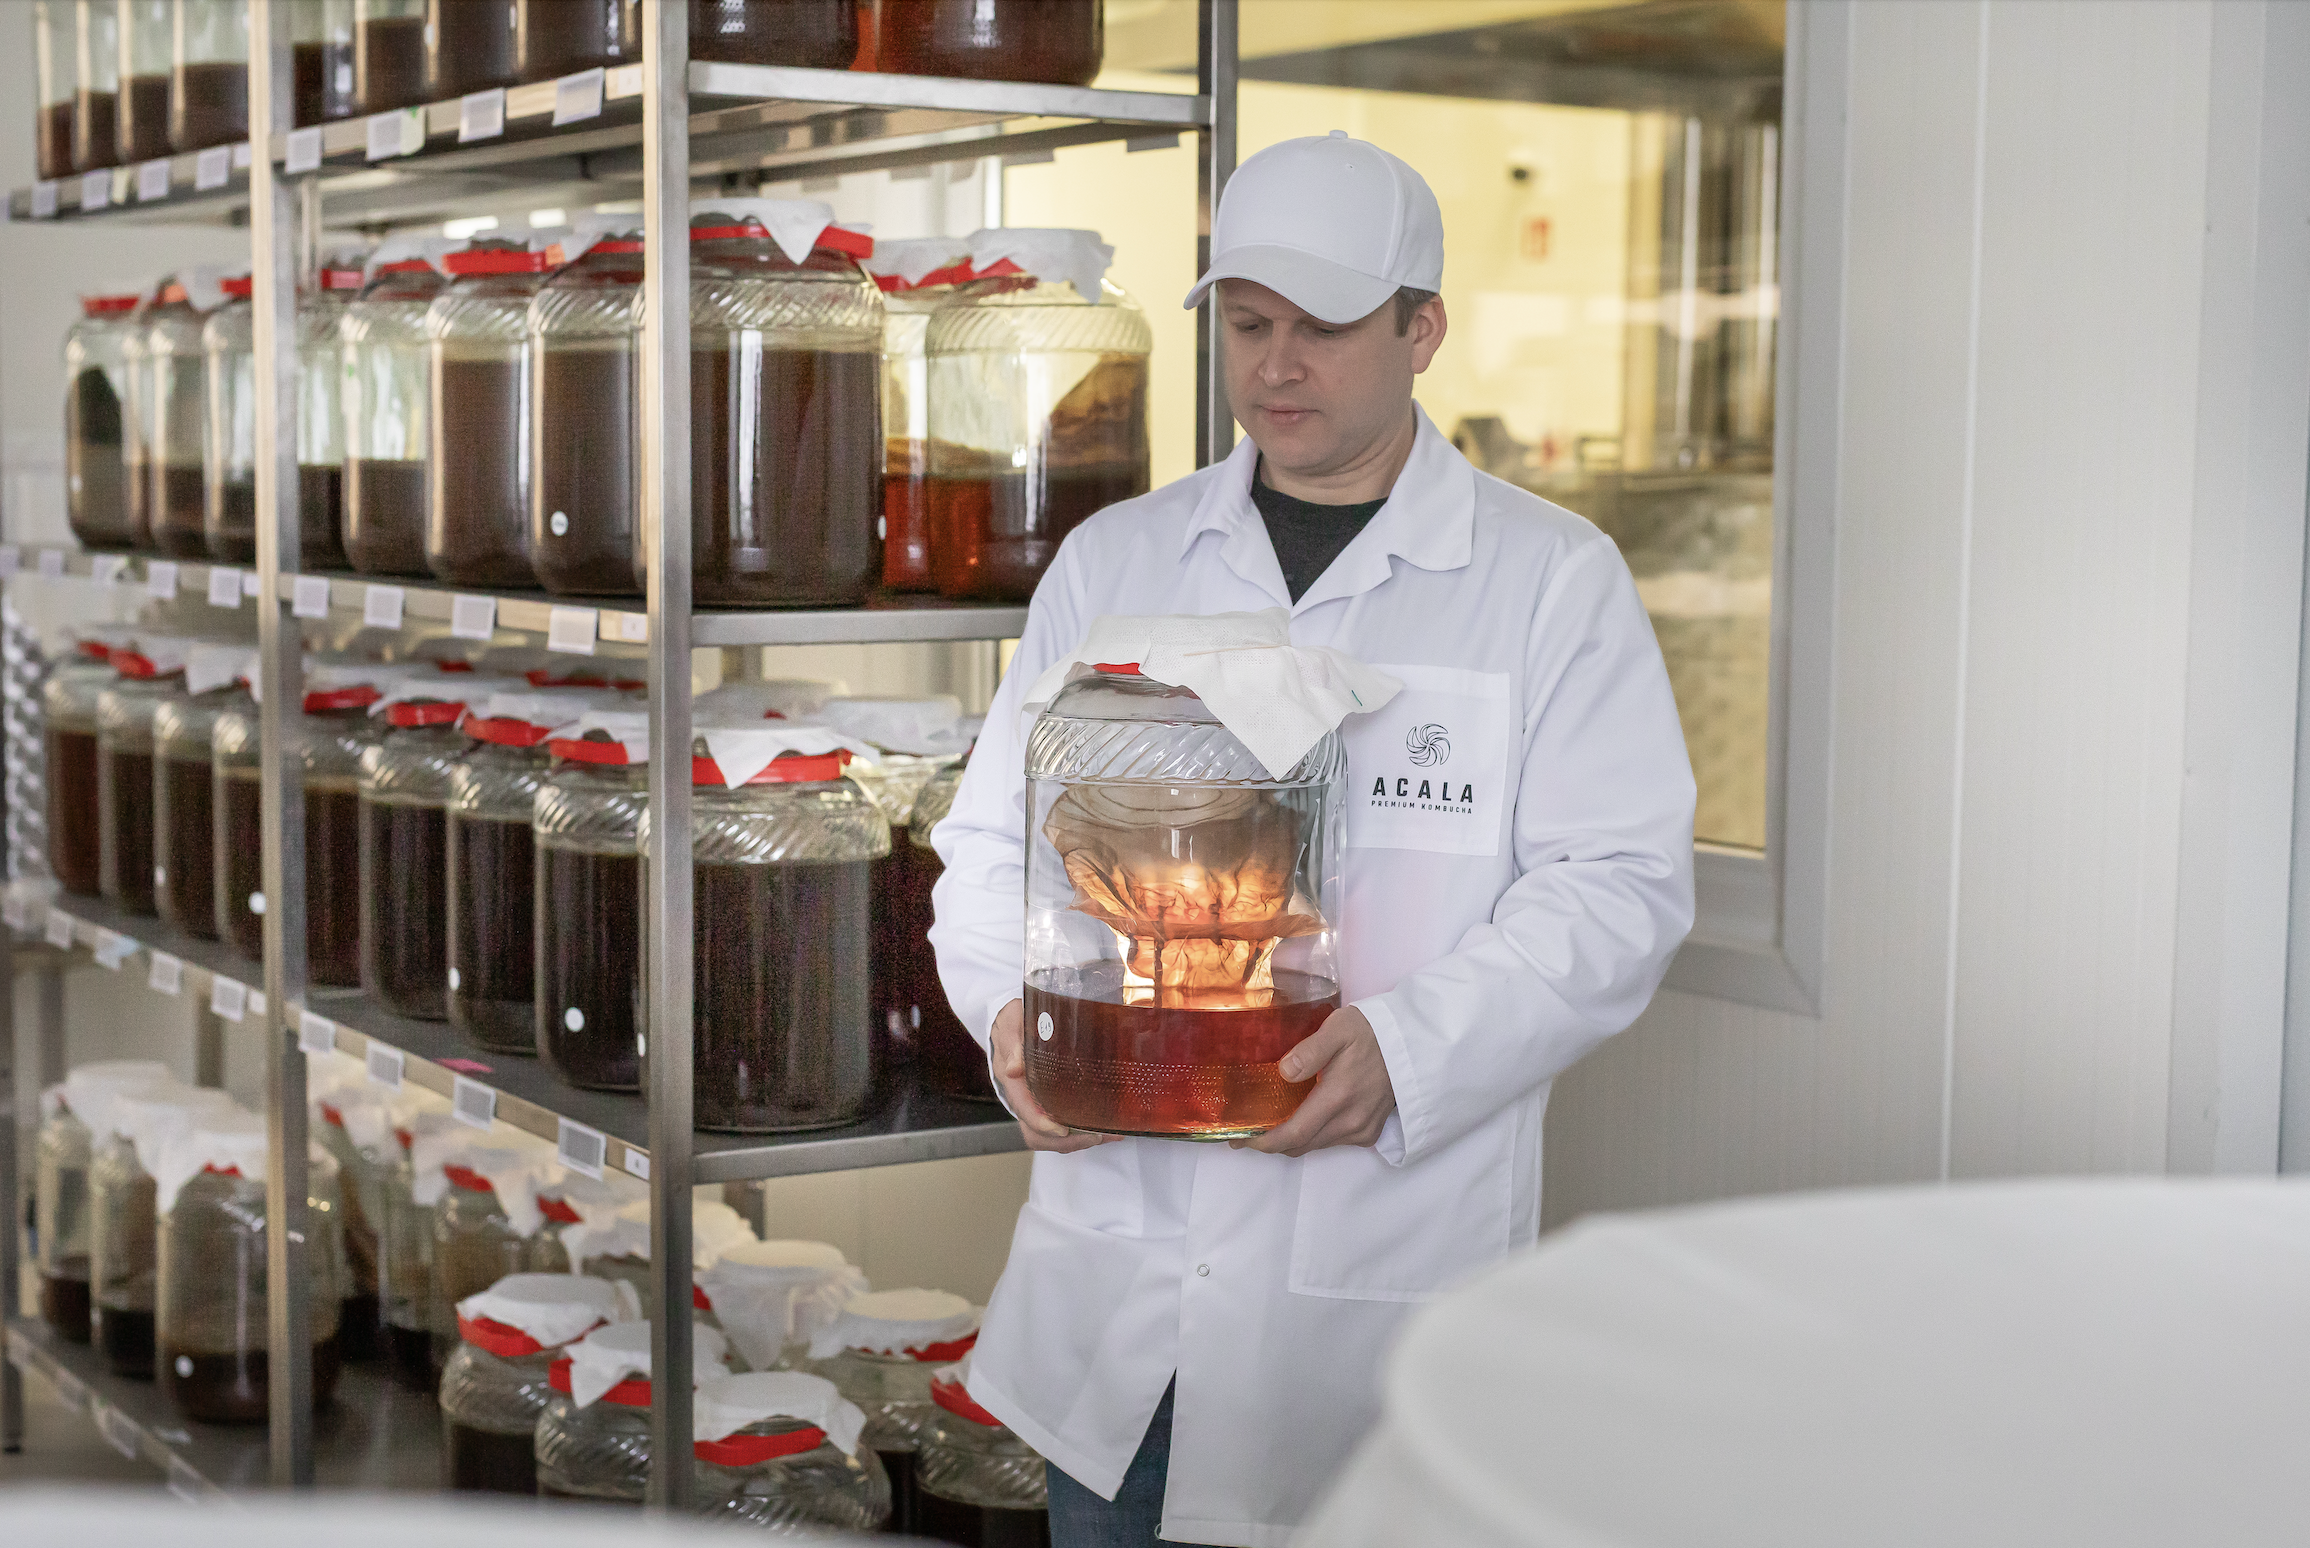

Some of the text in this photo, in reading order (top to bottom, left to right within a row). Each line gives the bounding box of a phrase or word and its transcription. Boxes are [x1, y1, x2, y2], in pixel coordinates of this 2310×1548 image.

[1372, 776, 1473, 803] ACALA
[1371, 800, 1472, 814] PREMIUM KOMBUCHA
